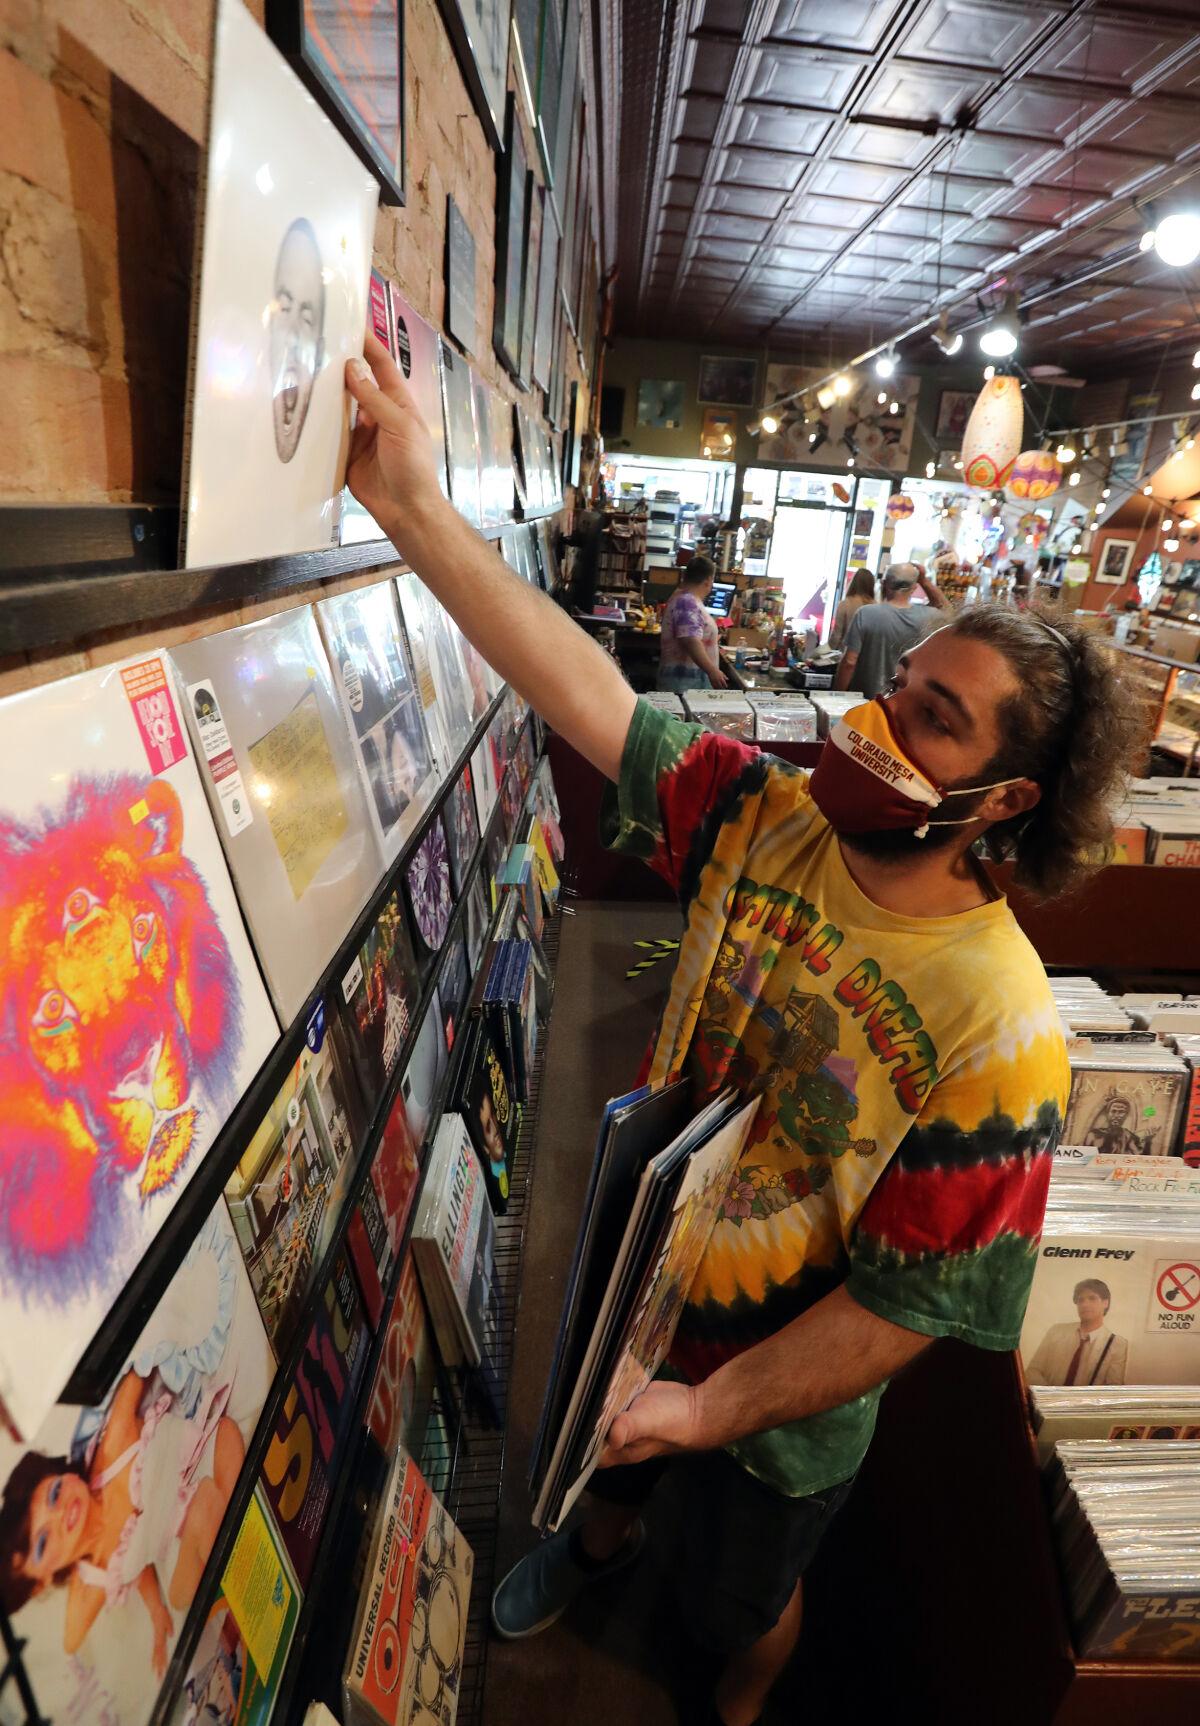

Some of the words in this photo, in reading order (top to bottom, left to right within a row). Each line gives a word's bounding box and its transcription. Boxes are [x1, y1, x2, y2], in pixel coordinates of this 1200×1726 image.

[847, 730, 892, 766] COLORADO
[889, 759, 915, 783] MESA
[850, 746, 900, 784] UNIVERSITY
[833, 958, 940, 1115] DREAD
[1116, 1079, 1175, 1095] GAYE
[1043, 1247, 1093, 1259] Glenn
[1094, 1248, 1136, 1261] Frey
[1158, 1313, 1174, 1321] NO
[1176, 1313, 1195, 1321] FUN
[355, 1582, 384, 1679] UNIVERSAL
[378, 1514, 397, 1577] RECORD
[1123, 1598, 1200, 1619] FLE
